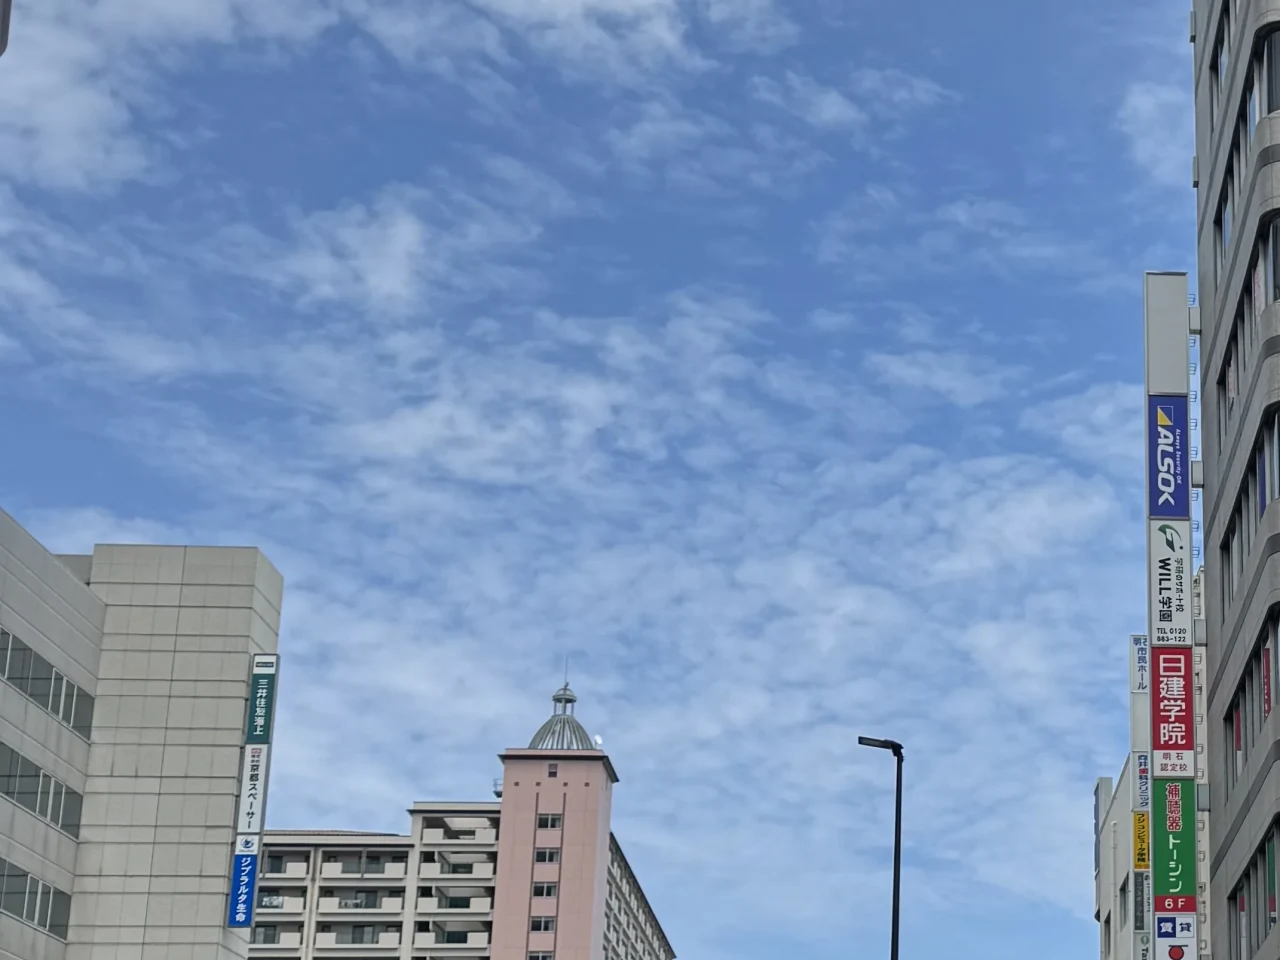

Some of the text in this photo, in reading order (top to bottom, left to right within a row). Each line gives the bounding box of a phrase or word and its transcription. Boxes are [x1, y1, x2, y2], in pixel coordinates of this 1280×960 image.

[1157, 428, 1175, 506] ALSOK
[1158, 558, 1173, 622] WILL学園
[1157, 627, 1186, 635] TEL 0120
[252, 680, 268, 735] 三井住友海上
[1159, 654, 1186, 745] 日建学院
[1160, 763, 1187, 772] 認定校
[1163, 752, 1184, 761] 明石
[1165, 783, 1182, 832] 補聴器
[235, 857, 251, 923] ジブラルタ生命
[1168, 834, 1182, 893] トーシン
